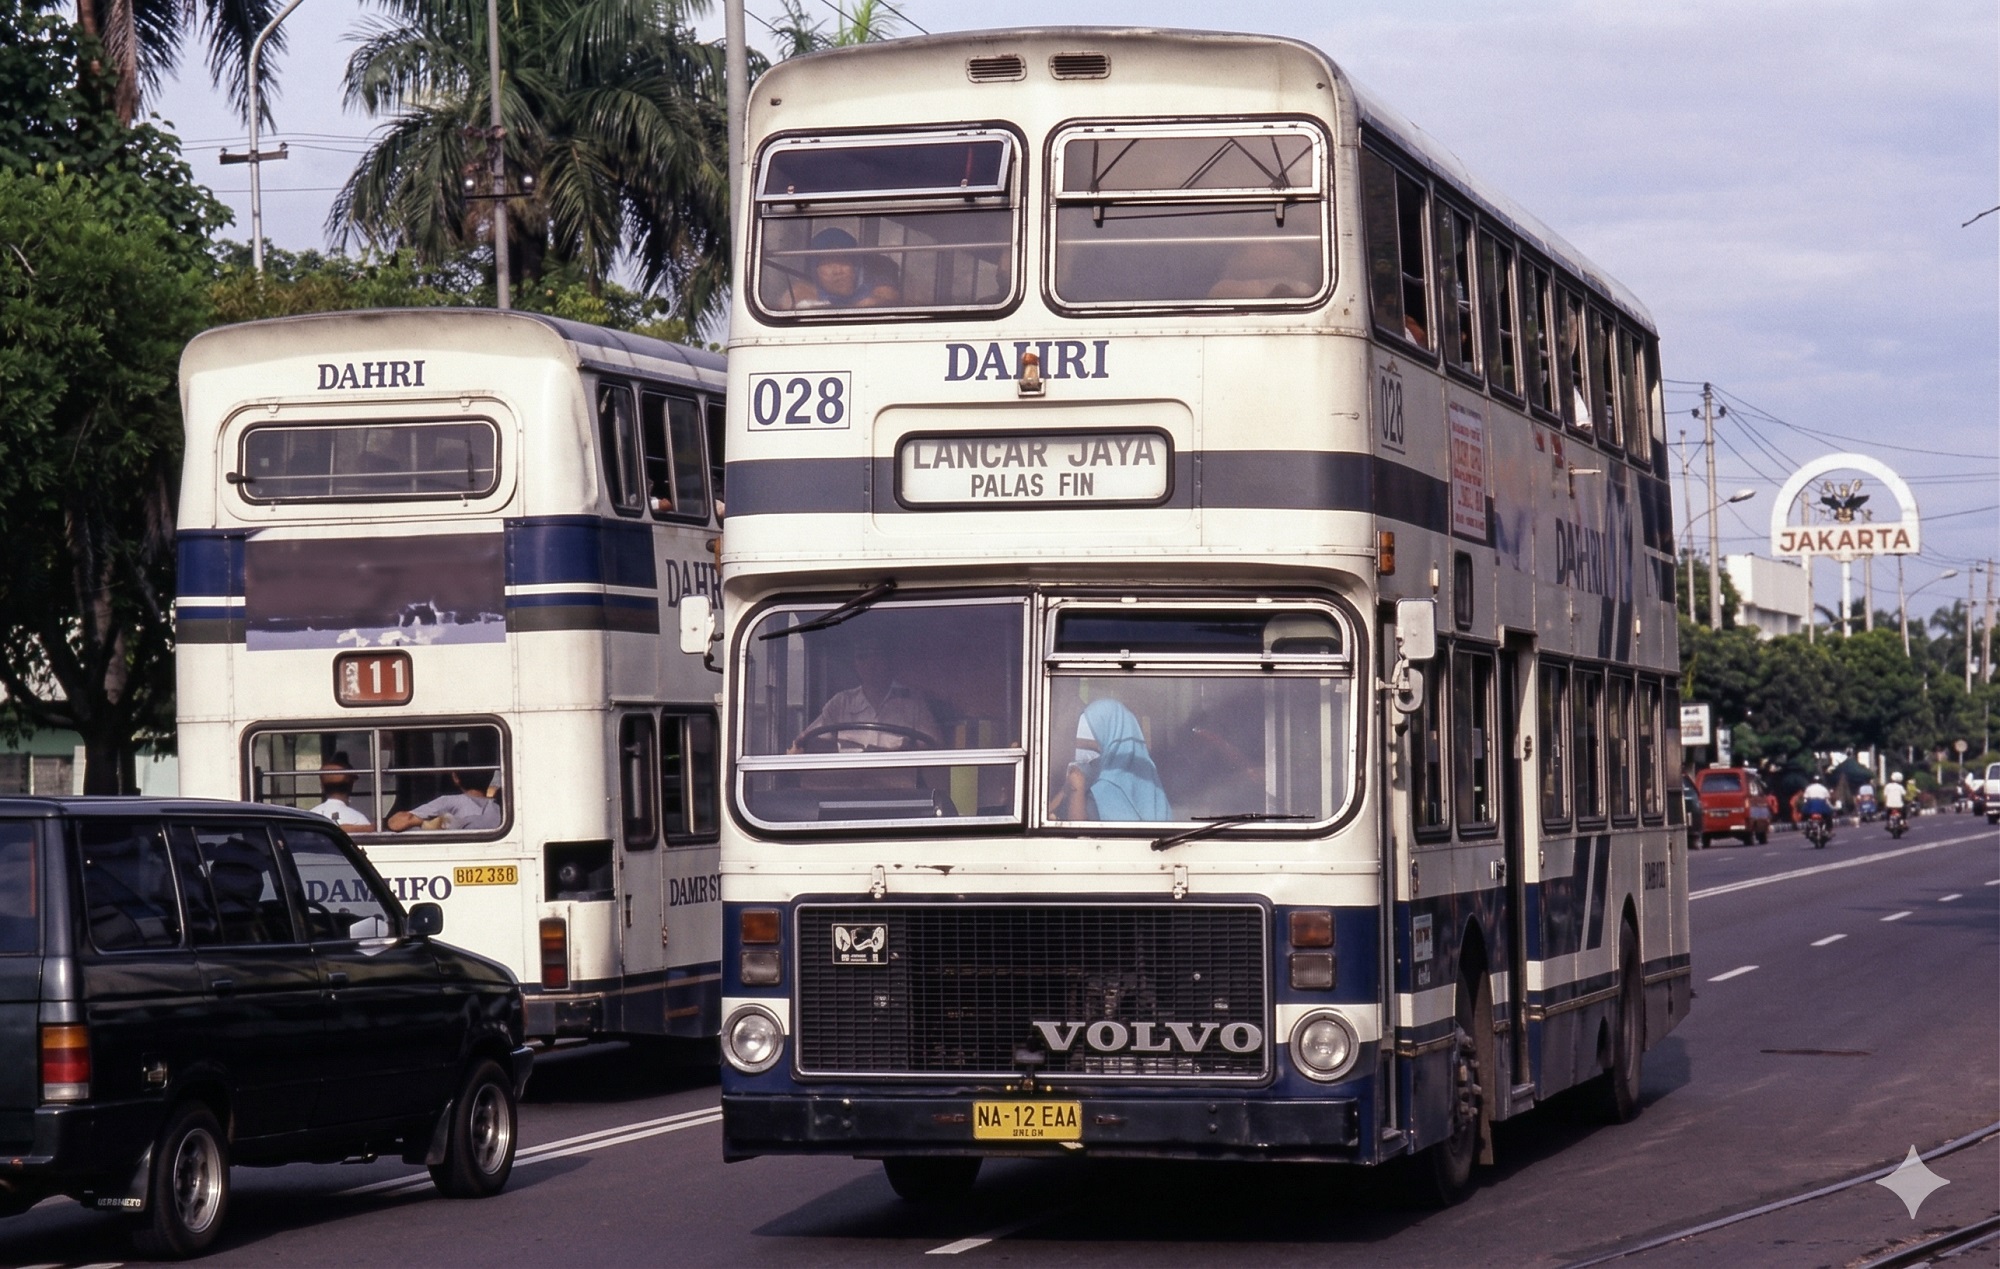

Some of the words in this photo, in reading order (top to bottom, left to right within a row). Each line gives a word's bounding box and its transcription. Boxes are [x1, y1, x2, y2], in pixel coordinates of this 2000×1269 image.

[317, 360, 426, 390] DAHRI
[944, 340, 1110, 381] DAHRI
[753, 376, 845, 426] 028
[1381, 375, 1404, 445] 028
[913, 440, 1048, 469] LANCAR
[1067, 437, 1156, 467] JAYA
[971, 473, 1044, 498] PALAS
[1059, 472, 1094, 496] FIN
[1780, 528, 1911, 552] JAKARTA
[1032, 1020, 1263, 1053] VOLVO
[1042, 1105, 1077, 1128] EAA
